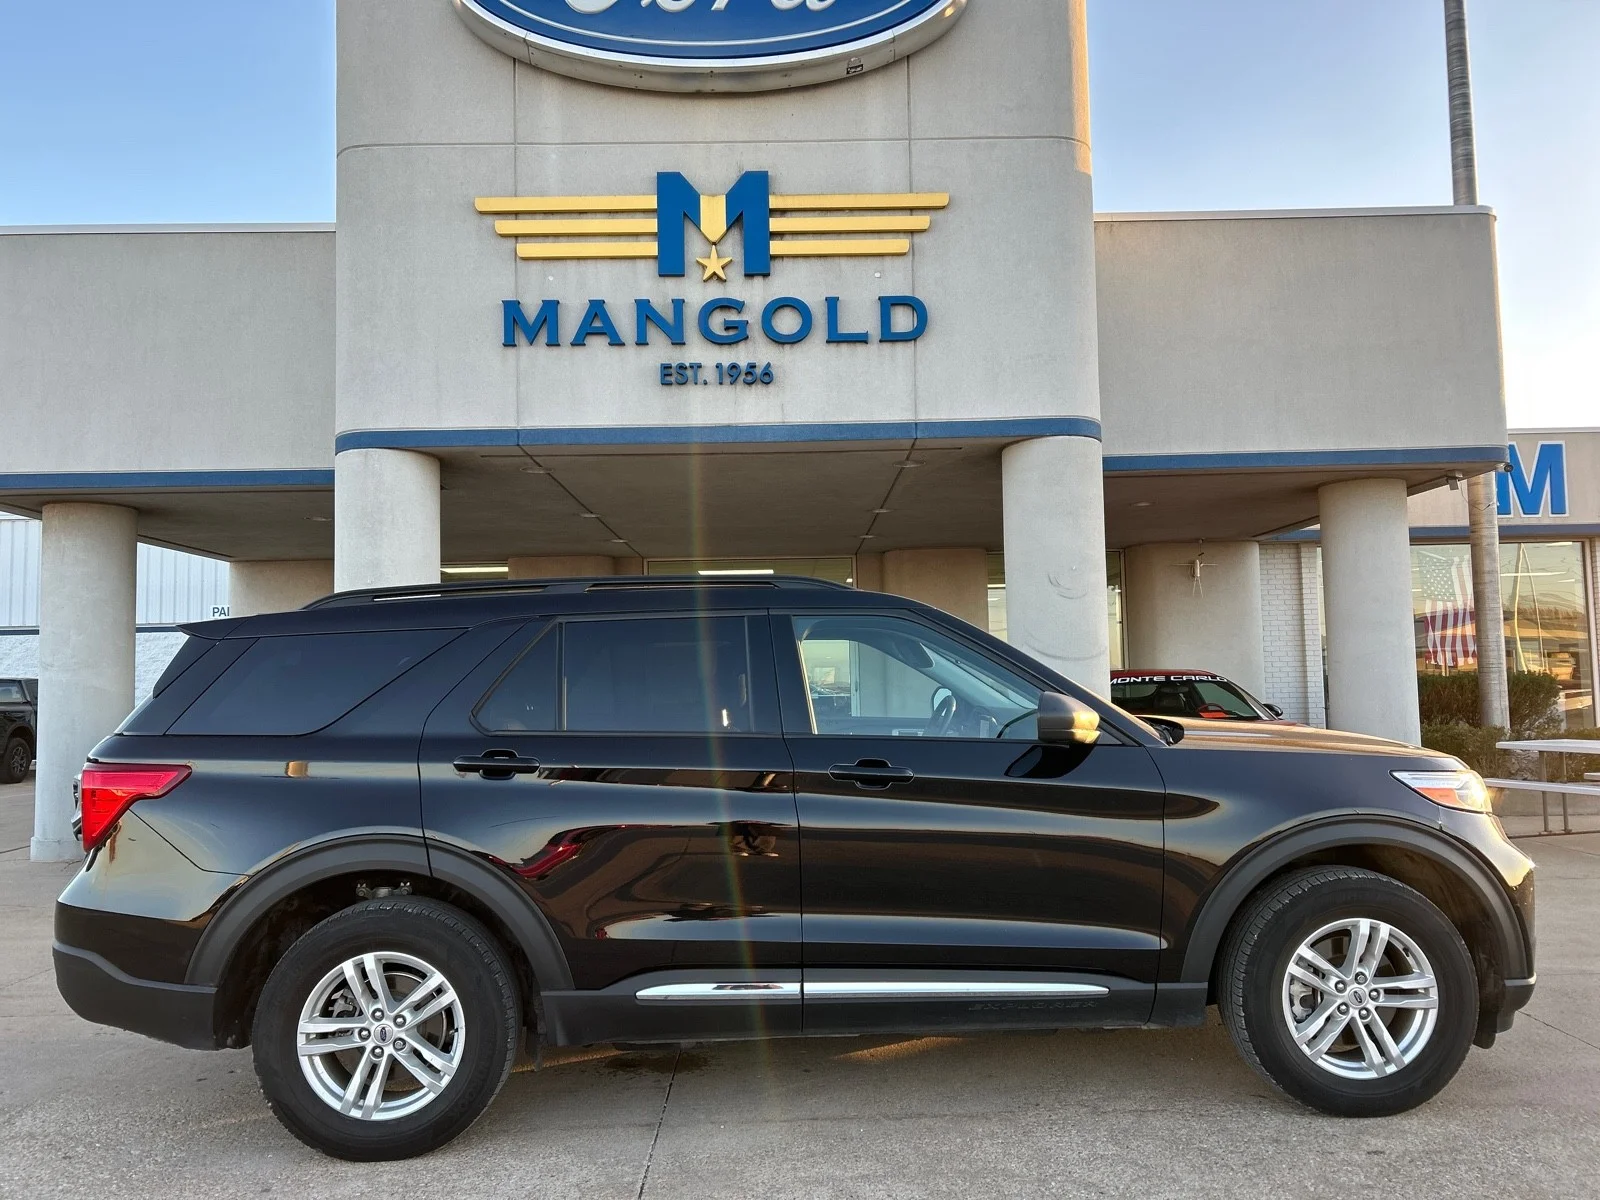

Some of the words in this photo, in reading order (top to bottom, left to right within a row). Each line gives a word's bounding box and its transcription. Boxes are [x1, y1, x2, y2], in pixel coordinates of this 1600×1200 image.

[656, 170, 770, 277] M
[502, 295, 928, 347] MANGOLD
[660, 362, 708, 385] EST.
[715, 361, 774, 385] 1956
[212, 606, 230, 617] PA
